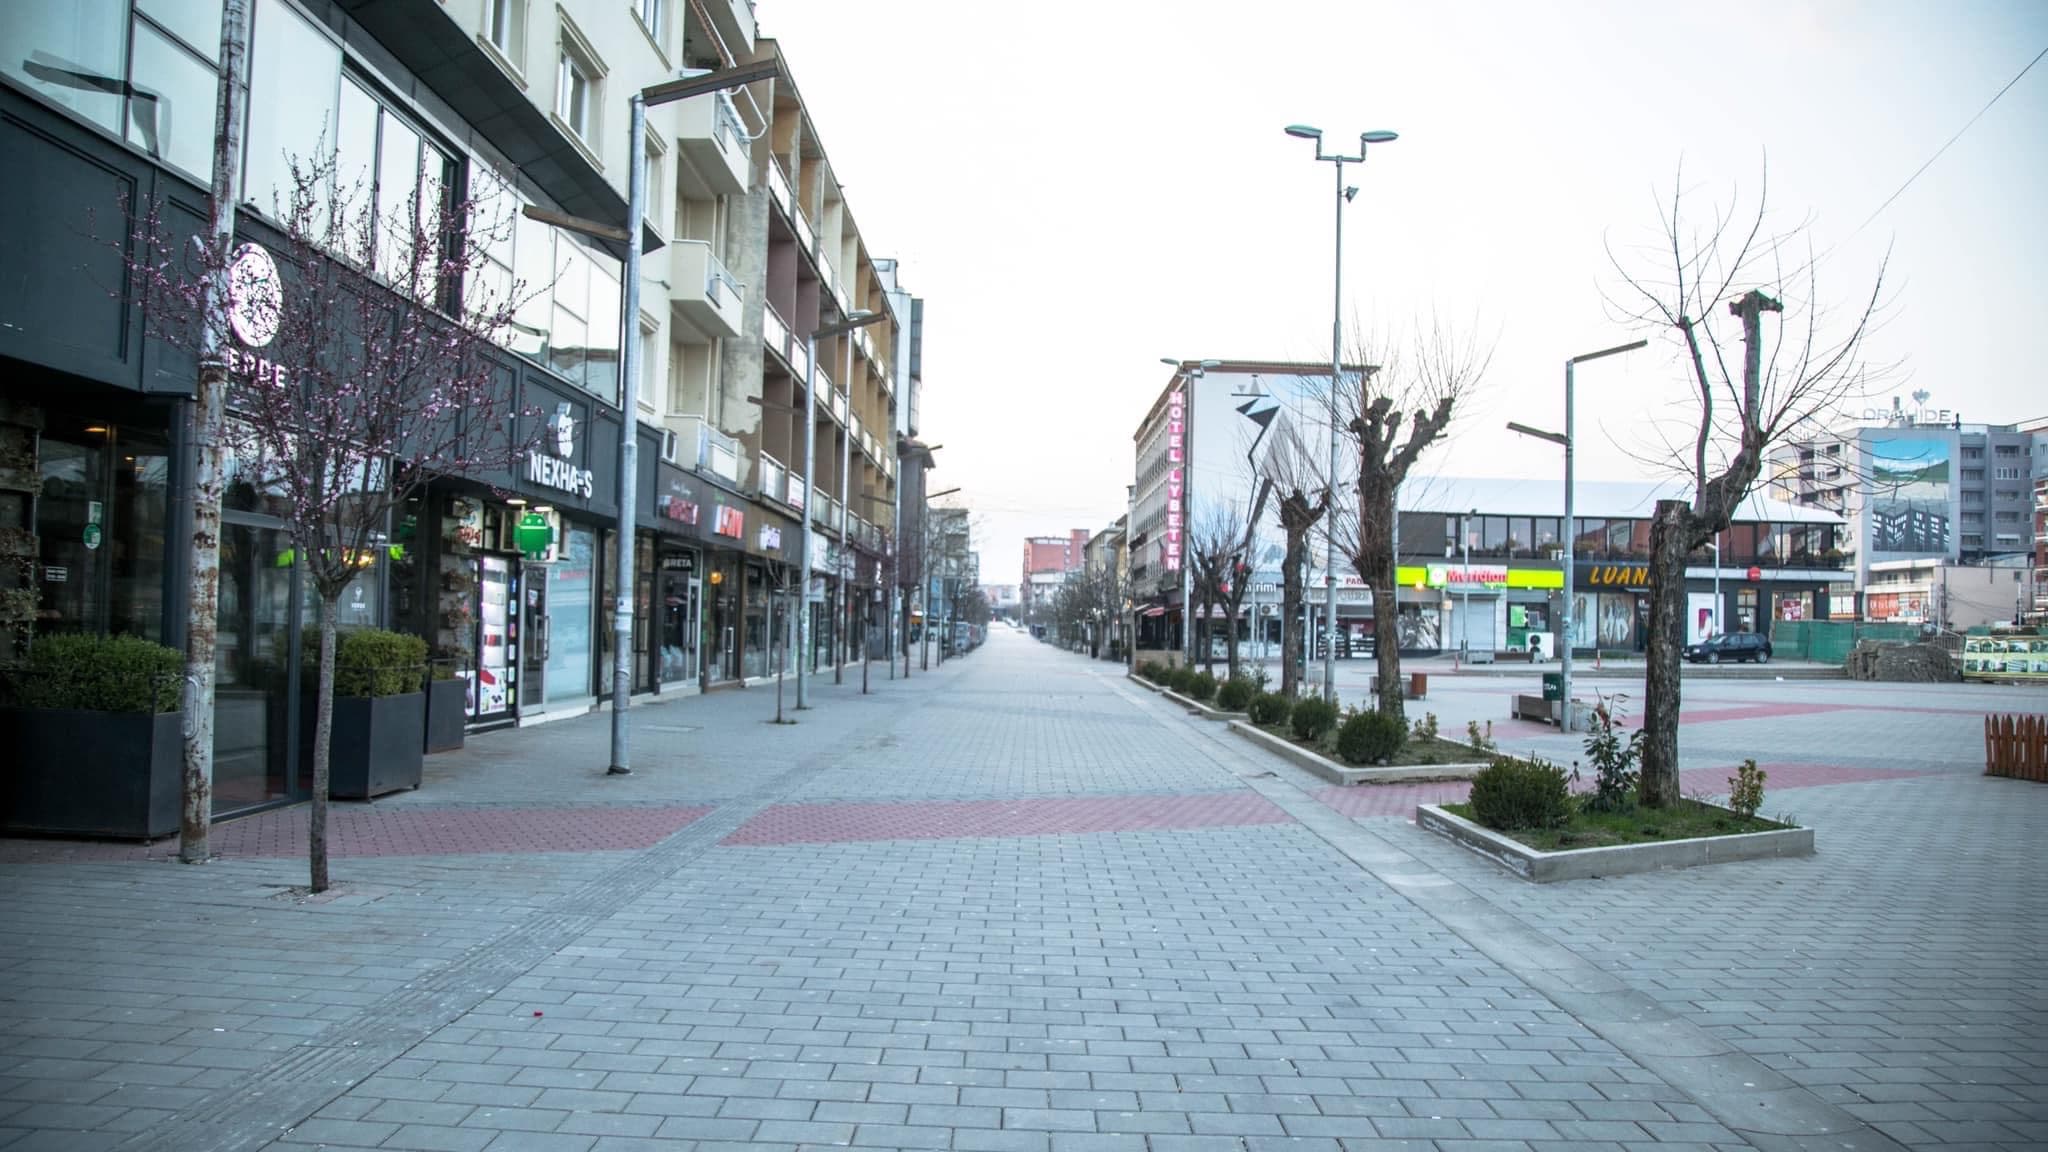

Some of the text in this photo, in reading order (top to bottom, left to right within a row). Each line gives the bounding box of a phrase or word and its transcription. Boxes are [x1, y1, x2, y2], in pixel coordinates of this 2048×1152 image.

[1167, 391, 1184, 571] HOTEL LYBETEN
[1589, 566, 1652, 585] LUAN
